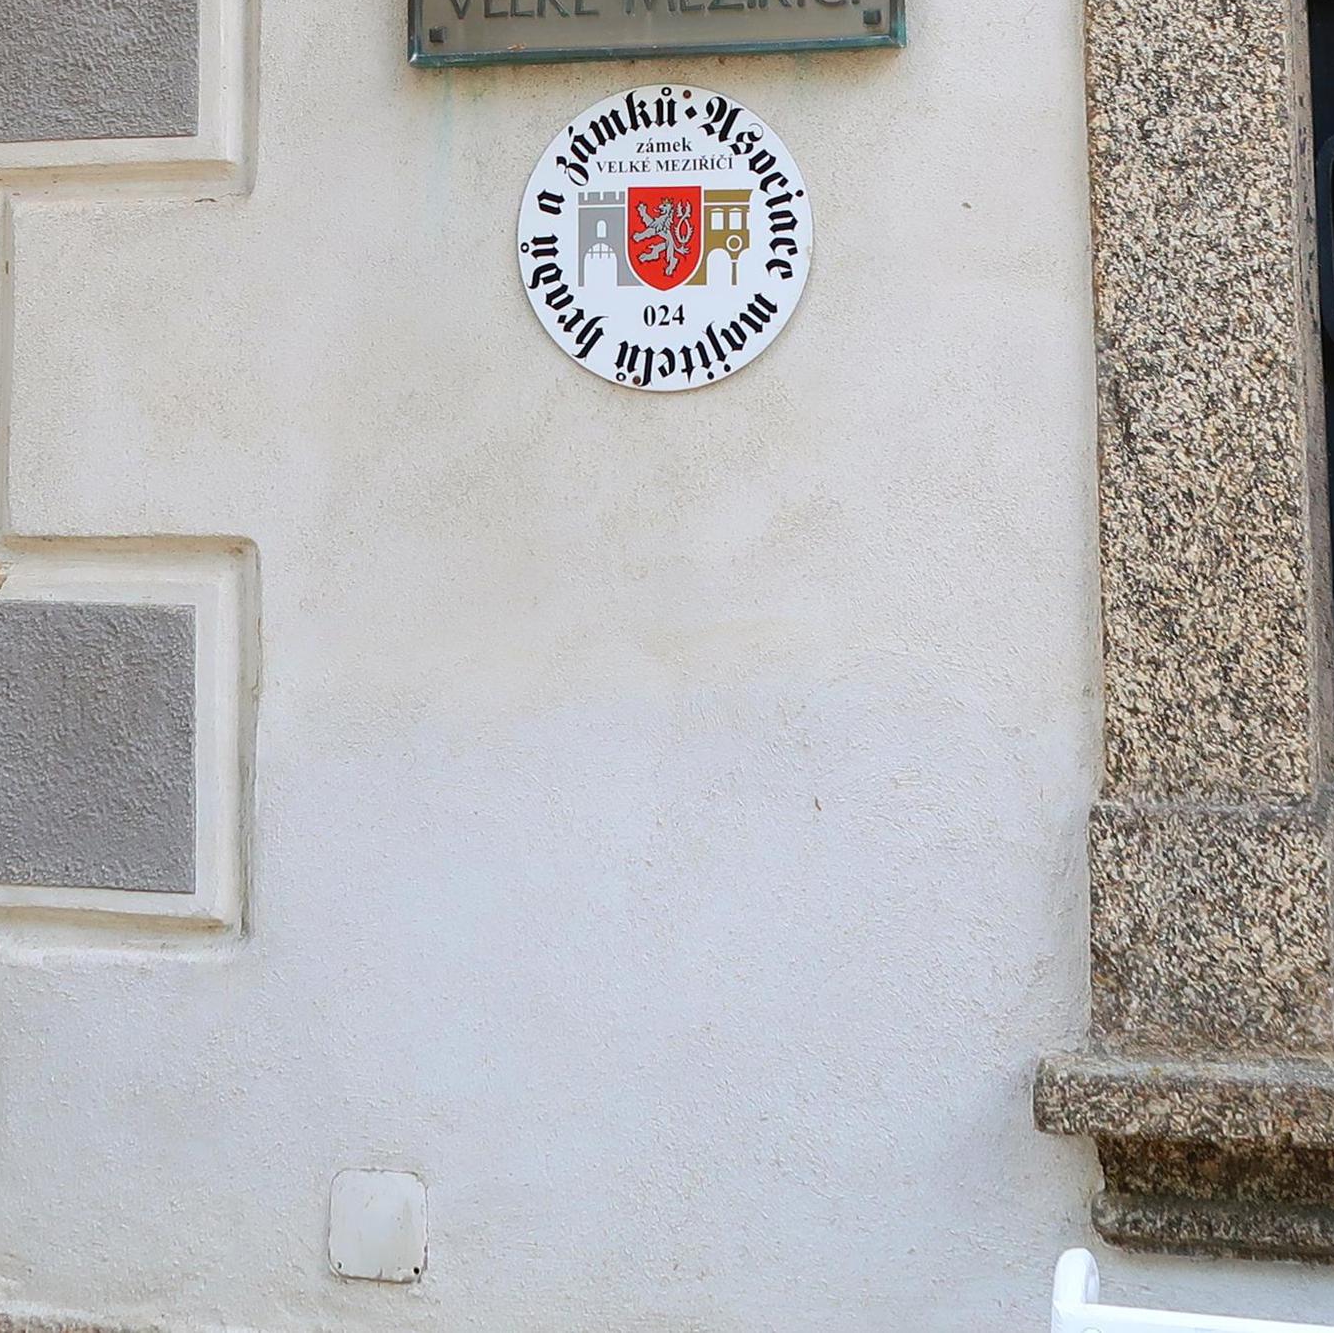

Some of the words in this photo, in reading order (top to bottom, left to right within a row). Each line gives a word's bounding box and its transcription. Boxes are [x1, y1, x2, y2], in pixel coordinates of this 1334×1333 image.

[636, 136, 693, 154] zámek
[597, 157, 652, 173] VELKÉ
[655, 153, 734, 172] MEZIŘÍČÍ
[537, 189, 565, 215] a
[520, 234, 609, 360] hradů
[643, 304, 686, 327] 024
[615, 292, 778, 387] majitelů
